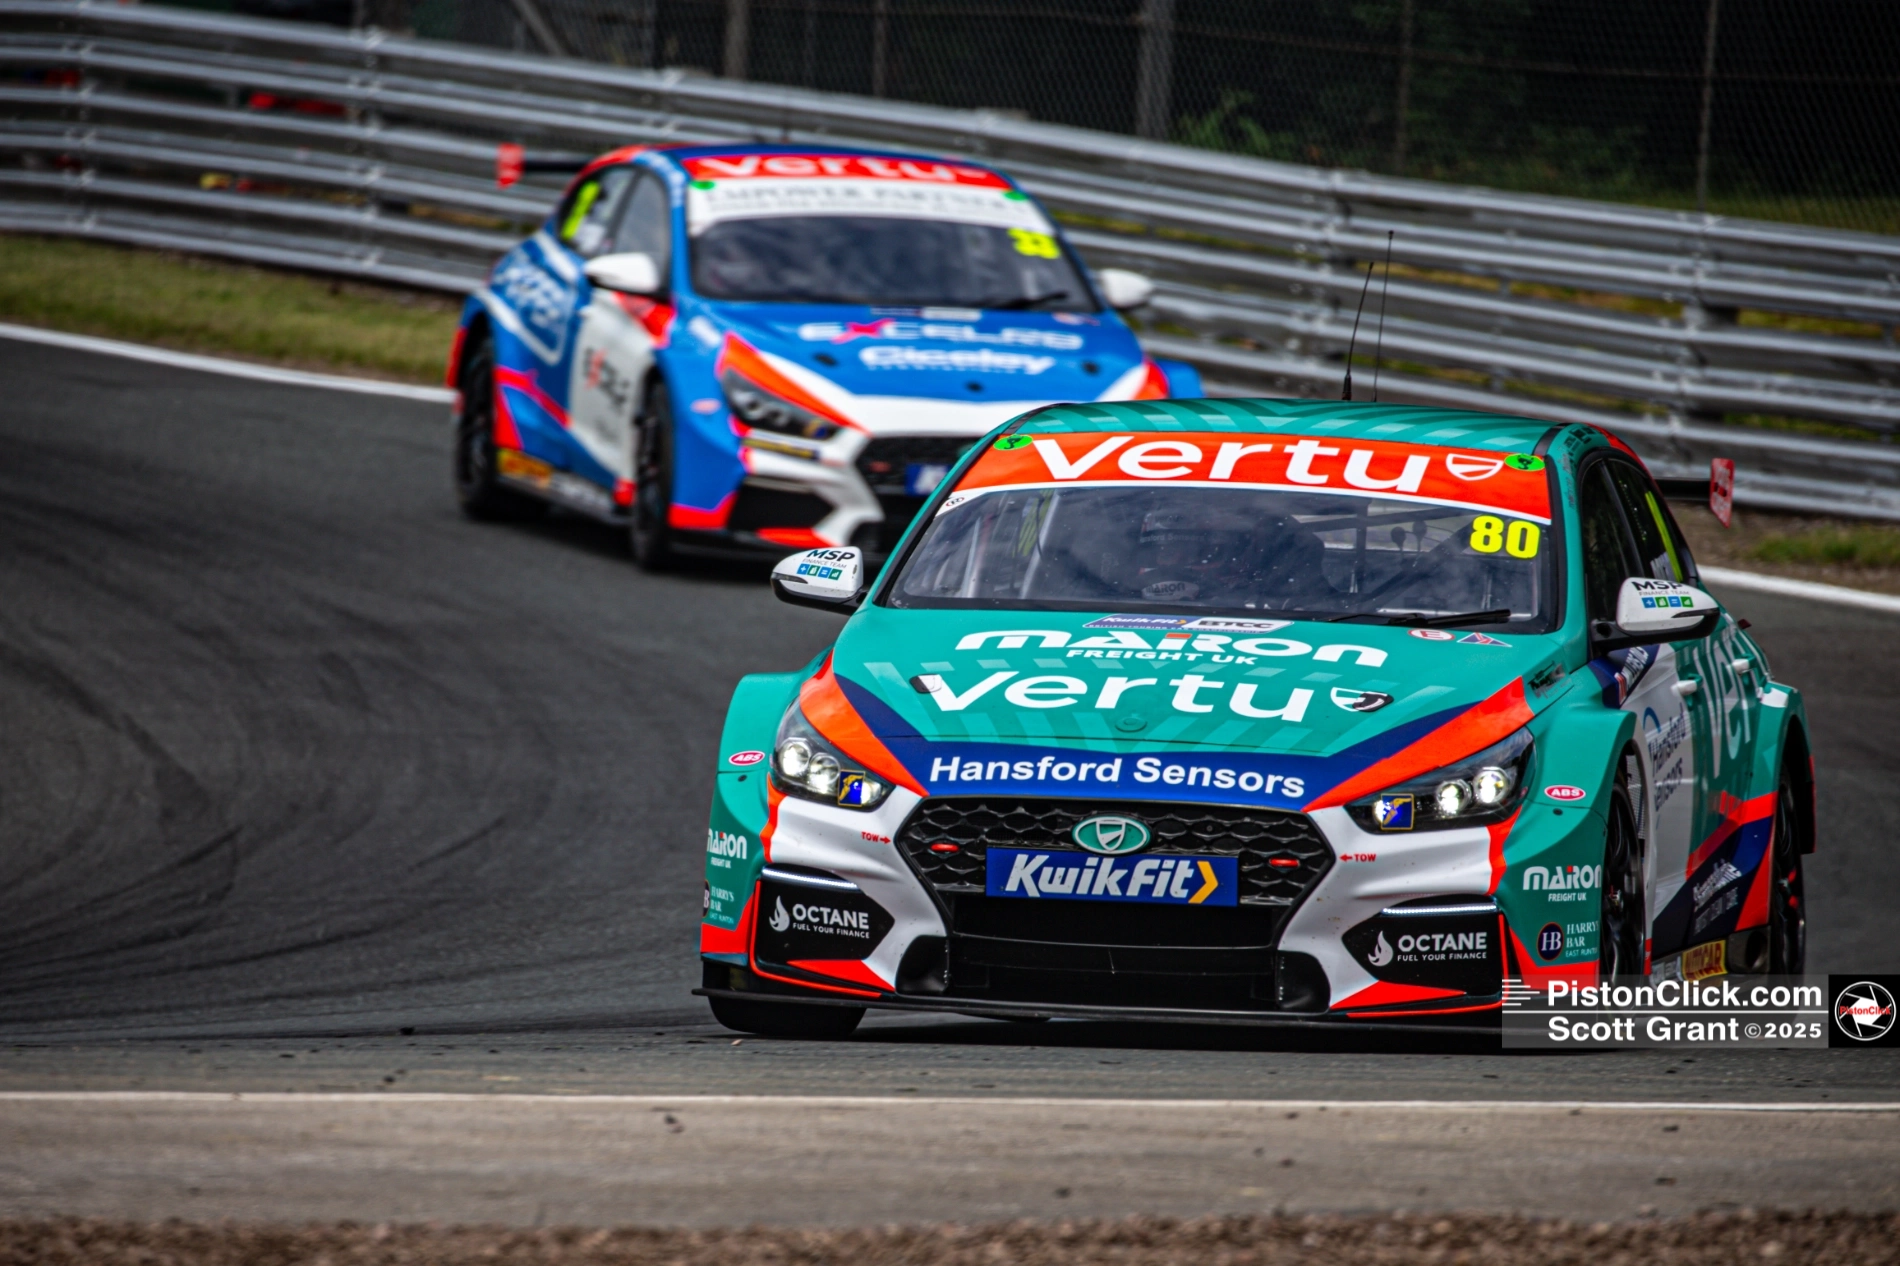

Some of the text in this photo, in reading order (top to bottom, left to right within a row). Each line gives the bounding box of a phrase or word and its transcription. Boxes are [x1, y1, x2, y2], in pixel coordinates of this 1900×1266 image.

[1033, 436, 1431, 493] Vertu
[1469, 515, 1540, 559] 80
[806, 549, 855, 561] MSP
[801, 558, 847, 569] FINANCE TEAM
[1198, 620, 1276, 630] BTCC
[1066, 649, 1259, 666] FREIGHT UK
[922, 671, 1316, 723] Vertu
[733, 753, 762, 762] ABS
[929, 756, 1306, 799] Hansford Sensors
[1551, 788, 1580, 798] ABS
[861, 832, 879, 842] TOW
[1354, 854, 1376, 862] TOW
[1548, 892, 1587, 902] FREIGHT UK
[792, 903, 870, 930] OCTANE
[792, 922, 870, 939] FUEL YOUR FINANCE
[1398, 932, 1487, 952] OCTANE
[1540, 931, 1562, 951] HB
[1566, 936, 1586, 948] BAR
[1397, 951, 1487, 962] FUEL YOUR FINANCE
[1565, 949, 1579, 958] EAST
